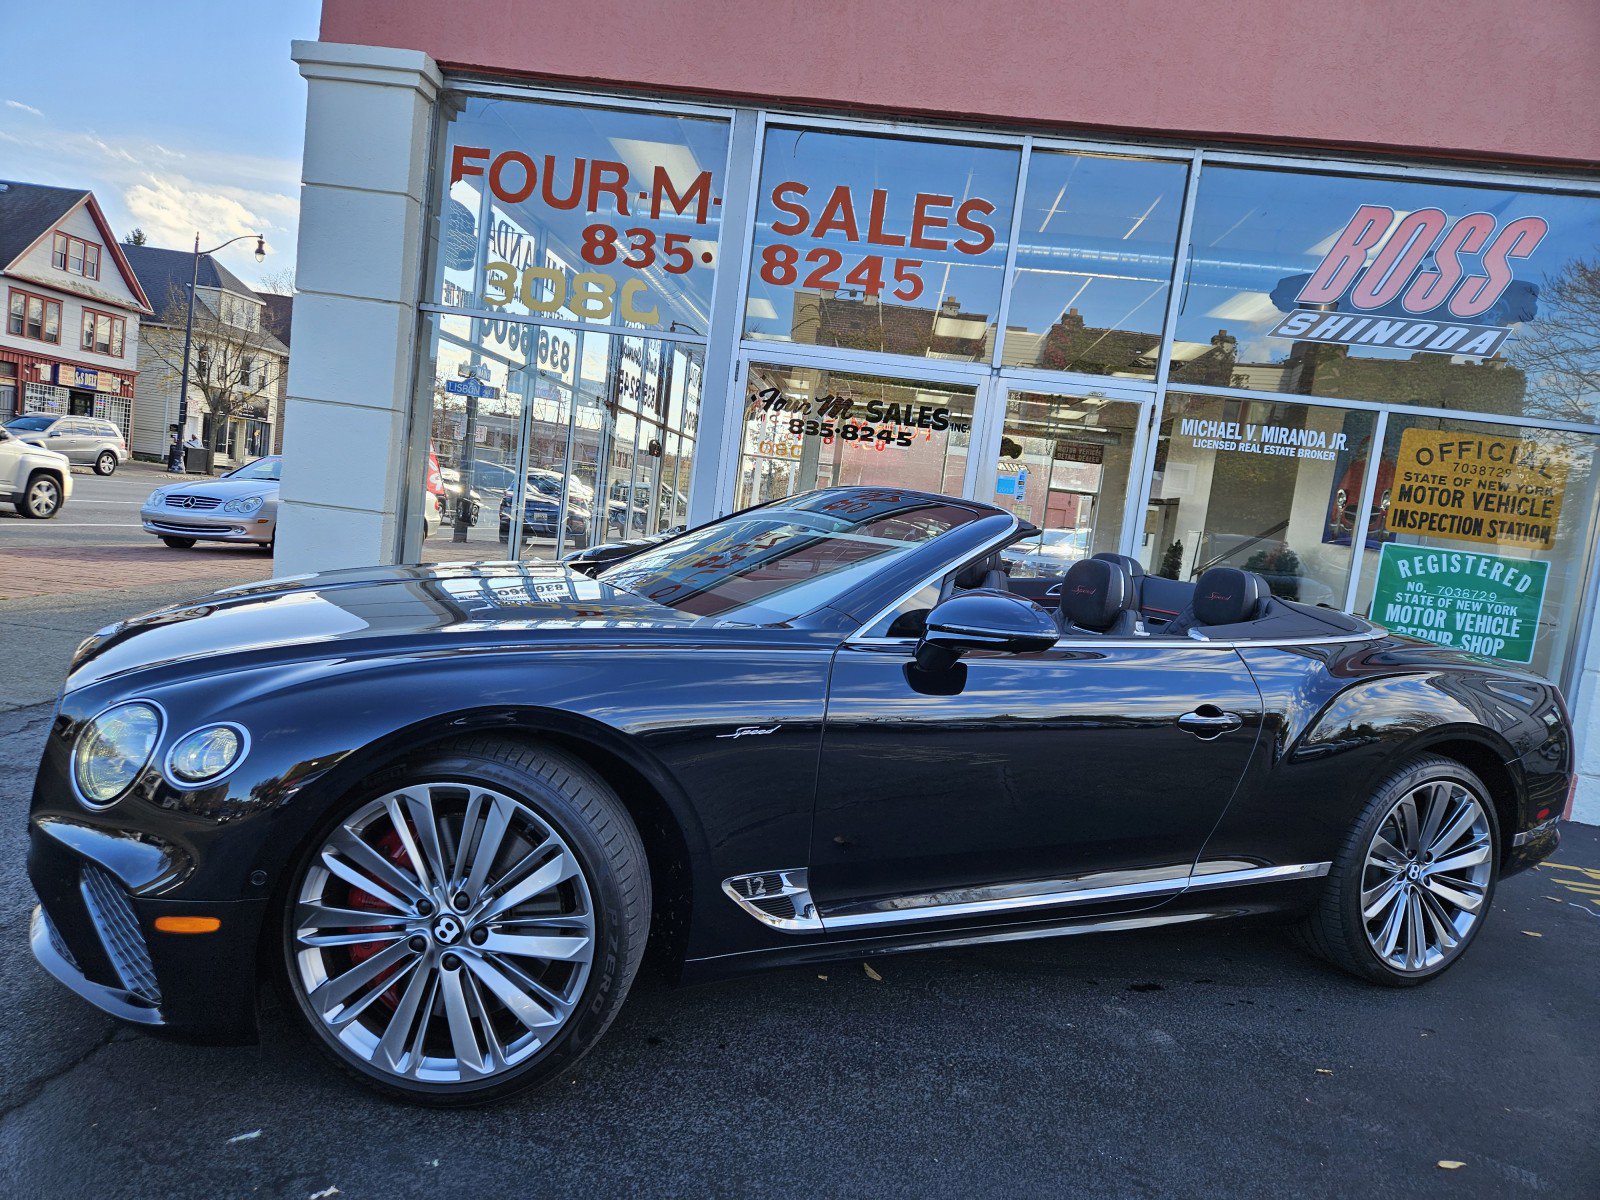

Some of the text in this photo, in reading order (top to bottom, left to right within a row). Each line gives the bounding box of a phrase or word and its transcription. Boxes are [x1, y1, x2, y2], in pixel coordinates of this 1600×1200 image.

[770, 181, 997, 256] SALES
[760, 243, 924, 301] 8245
[1293, 204, 1549, 319] BOSS
[1277, 311, 1502, 355] SHINODA
[448, 381, 481, 396] LISBON
[866, 399, 950, 431] SALES
[1180, 418, 1349, 451] MICHAEL V. MIRANDA JR.
[1193, 438, 1336, 461] LICENSED REAL ESTATE BROKER
[1415, 440, 1553, 480] OFFICIAL
[1452, 462, 1512, 478] 7038729
[1398, 483, 1555, 519] MOTOR VEHICLE
[1403, 471, 1554, 497] STATE OF NEW YORK
[1391, 508, 1552, 545] INSPECTION STATION
[1397, 553, 1532, 593] REGISTERED
[1395, 592, 1518, 617] STATE OF NEW YORK
[1406, 581, 1497, 602] NO. 7038729
[1385, 603, 1523, 638] MOTOR VEHICLE
[1459, 633, 1505, 657] SHOP
